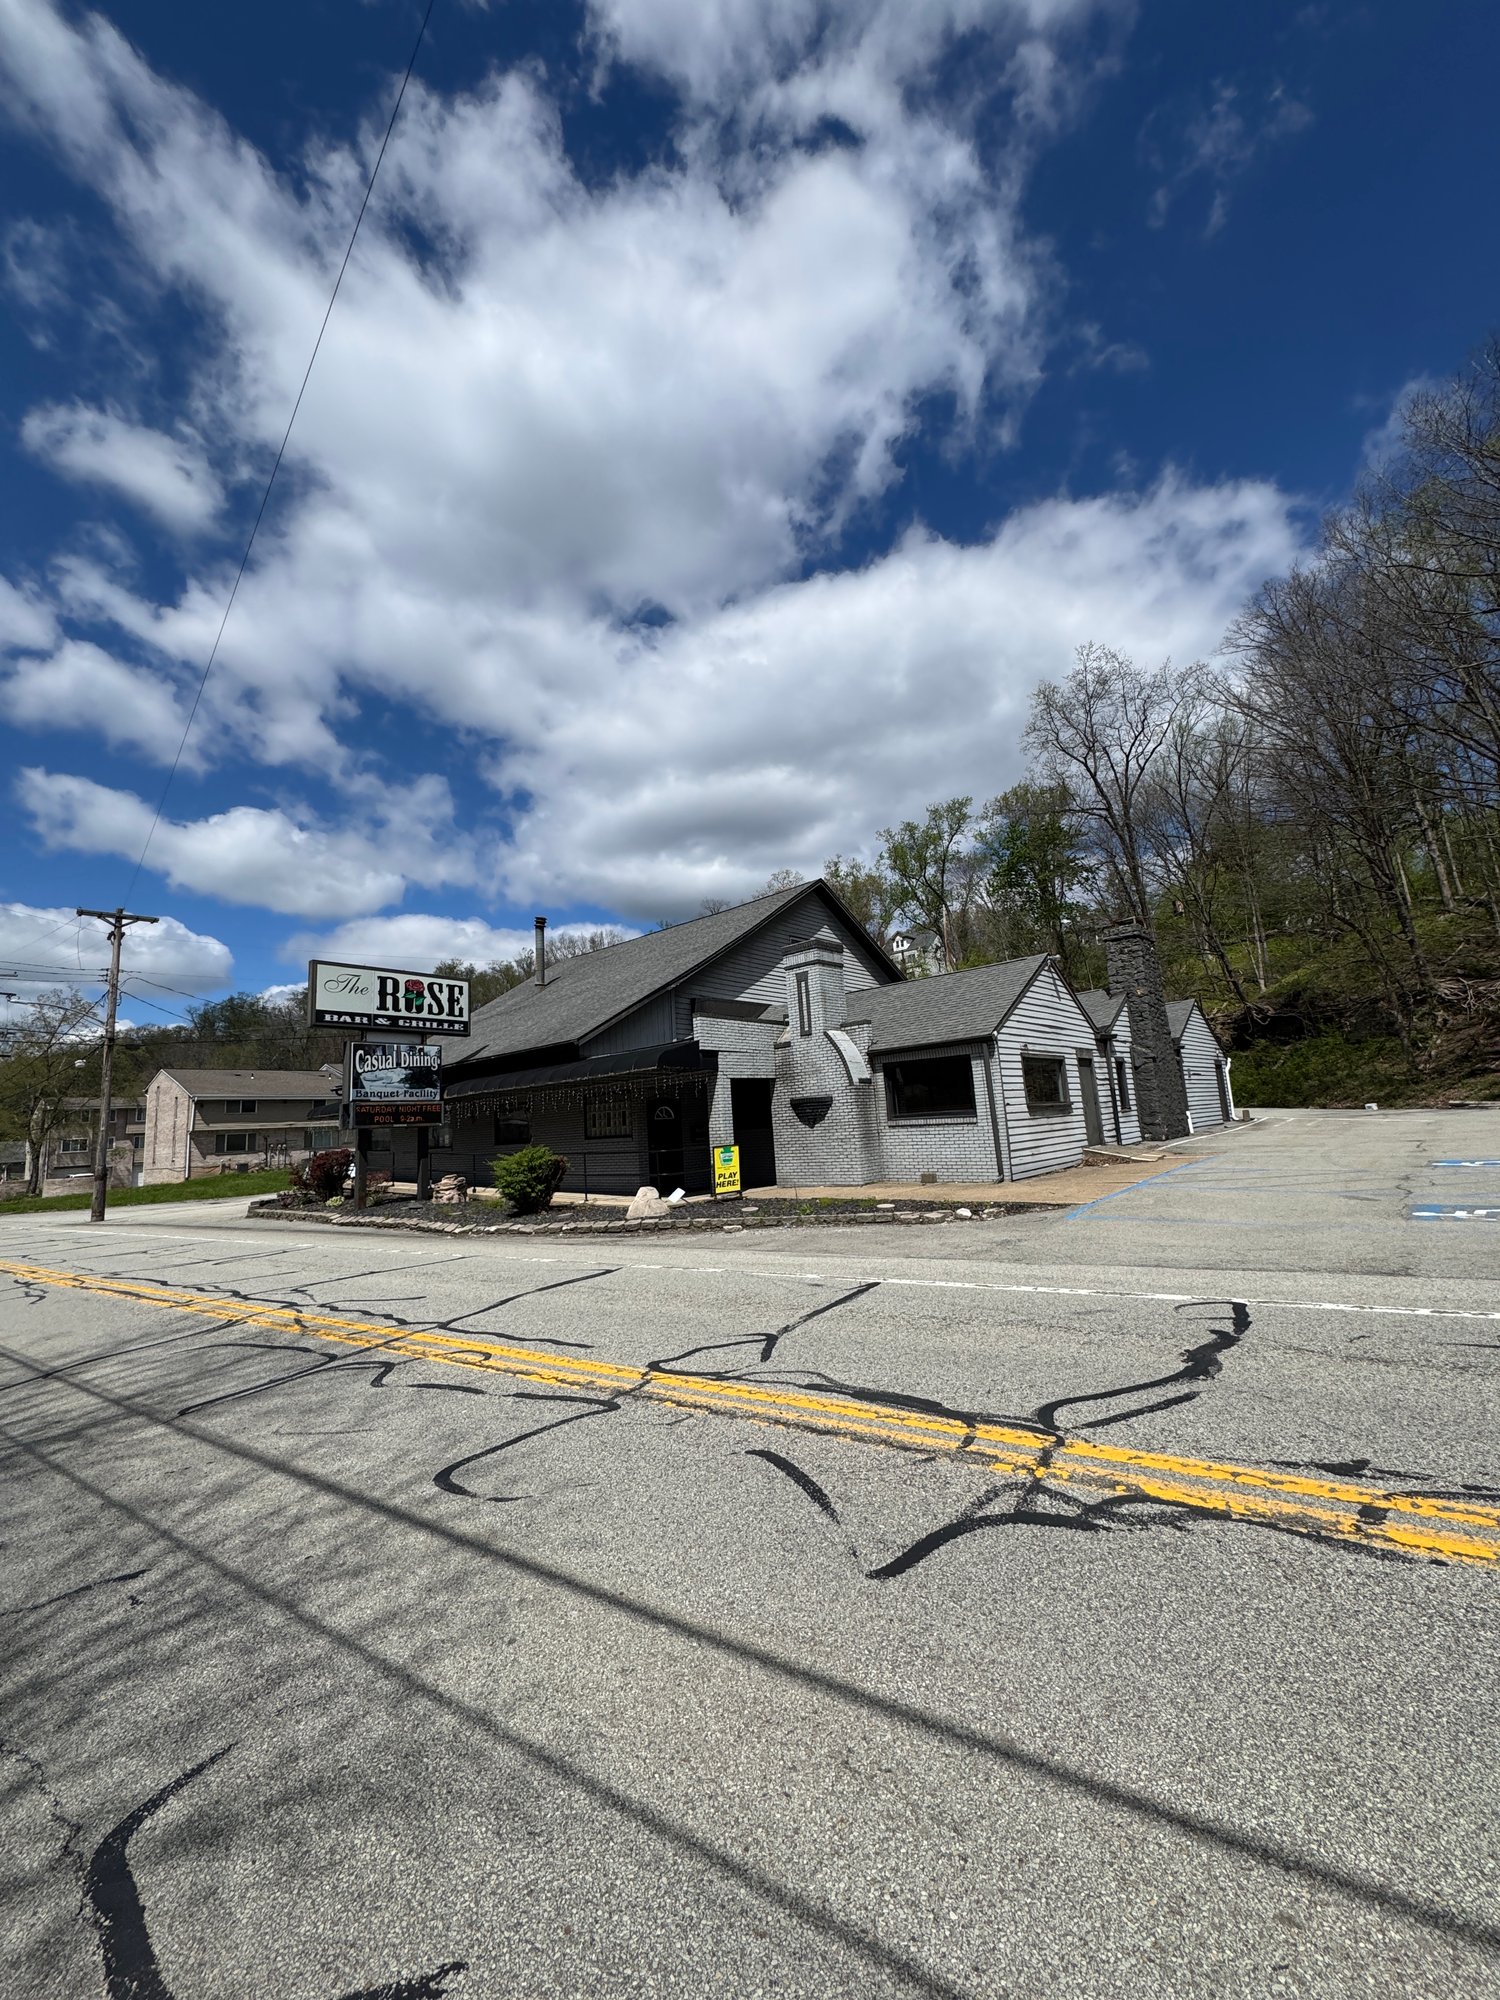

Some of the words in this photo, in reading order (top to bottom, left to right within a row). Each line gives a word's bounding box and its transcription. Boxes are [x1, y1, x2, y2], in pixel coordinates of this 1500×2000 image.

[323, 973, 370, 996] The
[376, 976, 464, 1018] ROSE
[323, 1013, 369, 1025] BAR
[374, 1017, 391, 1026] &
[398, 1019, 464, 1030] GRILLE
[355, 1050, 397, 1073] Casual
[400, 1051, 438, 1071] Dining
[355, 1090, 400, 1099] Banquet
[403, 1090, 438, 1099] Facility
[356, 1105, 396, 1113] SATURDAY
[374, 1115, 394, 1123] POOL
[718, 1172, 738, 1180] PLAY
[716, 1179, 739, 1188] HERE!
